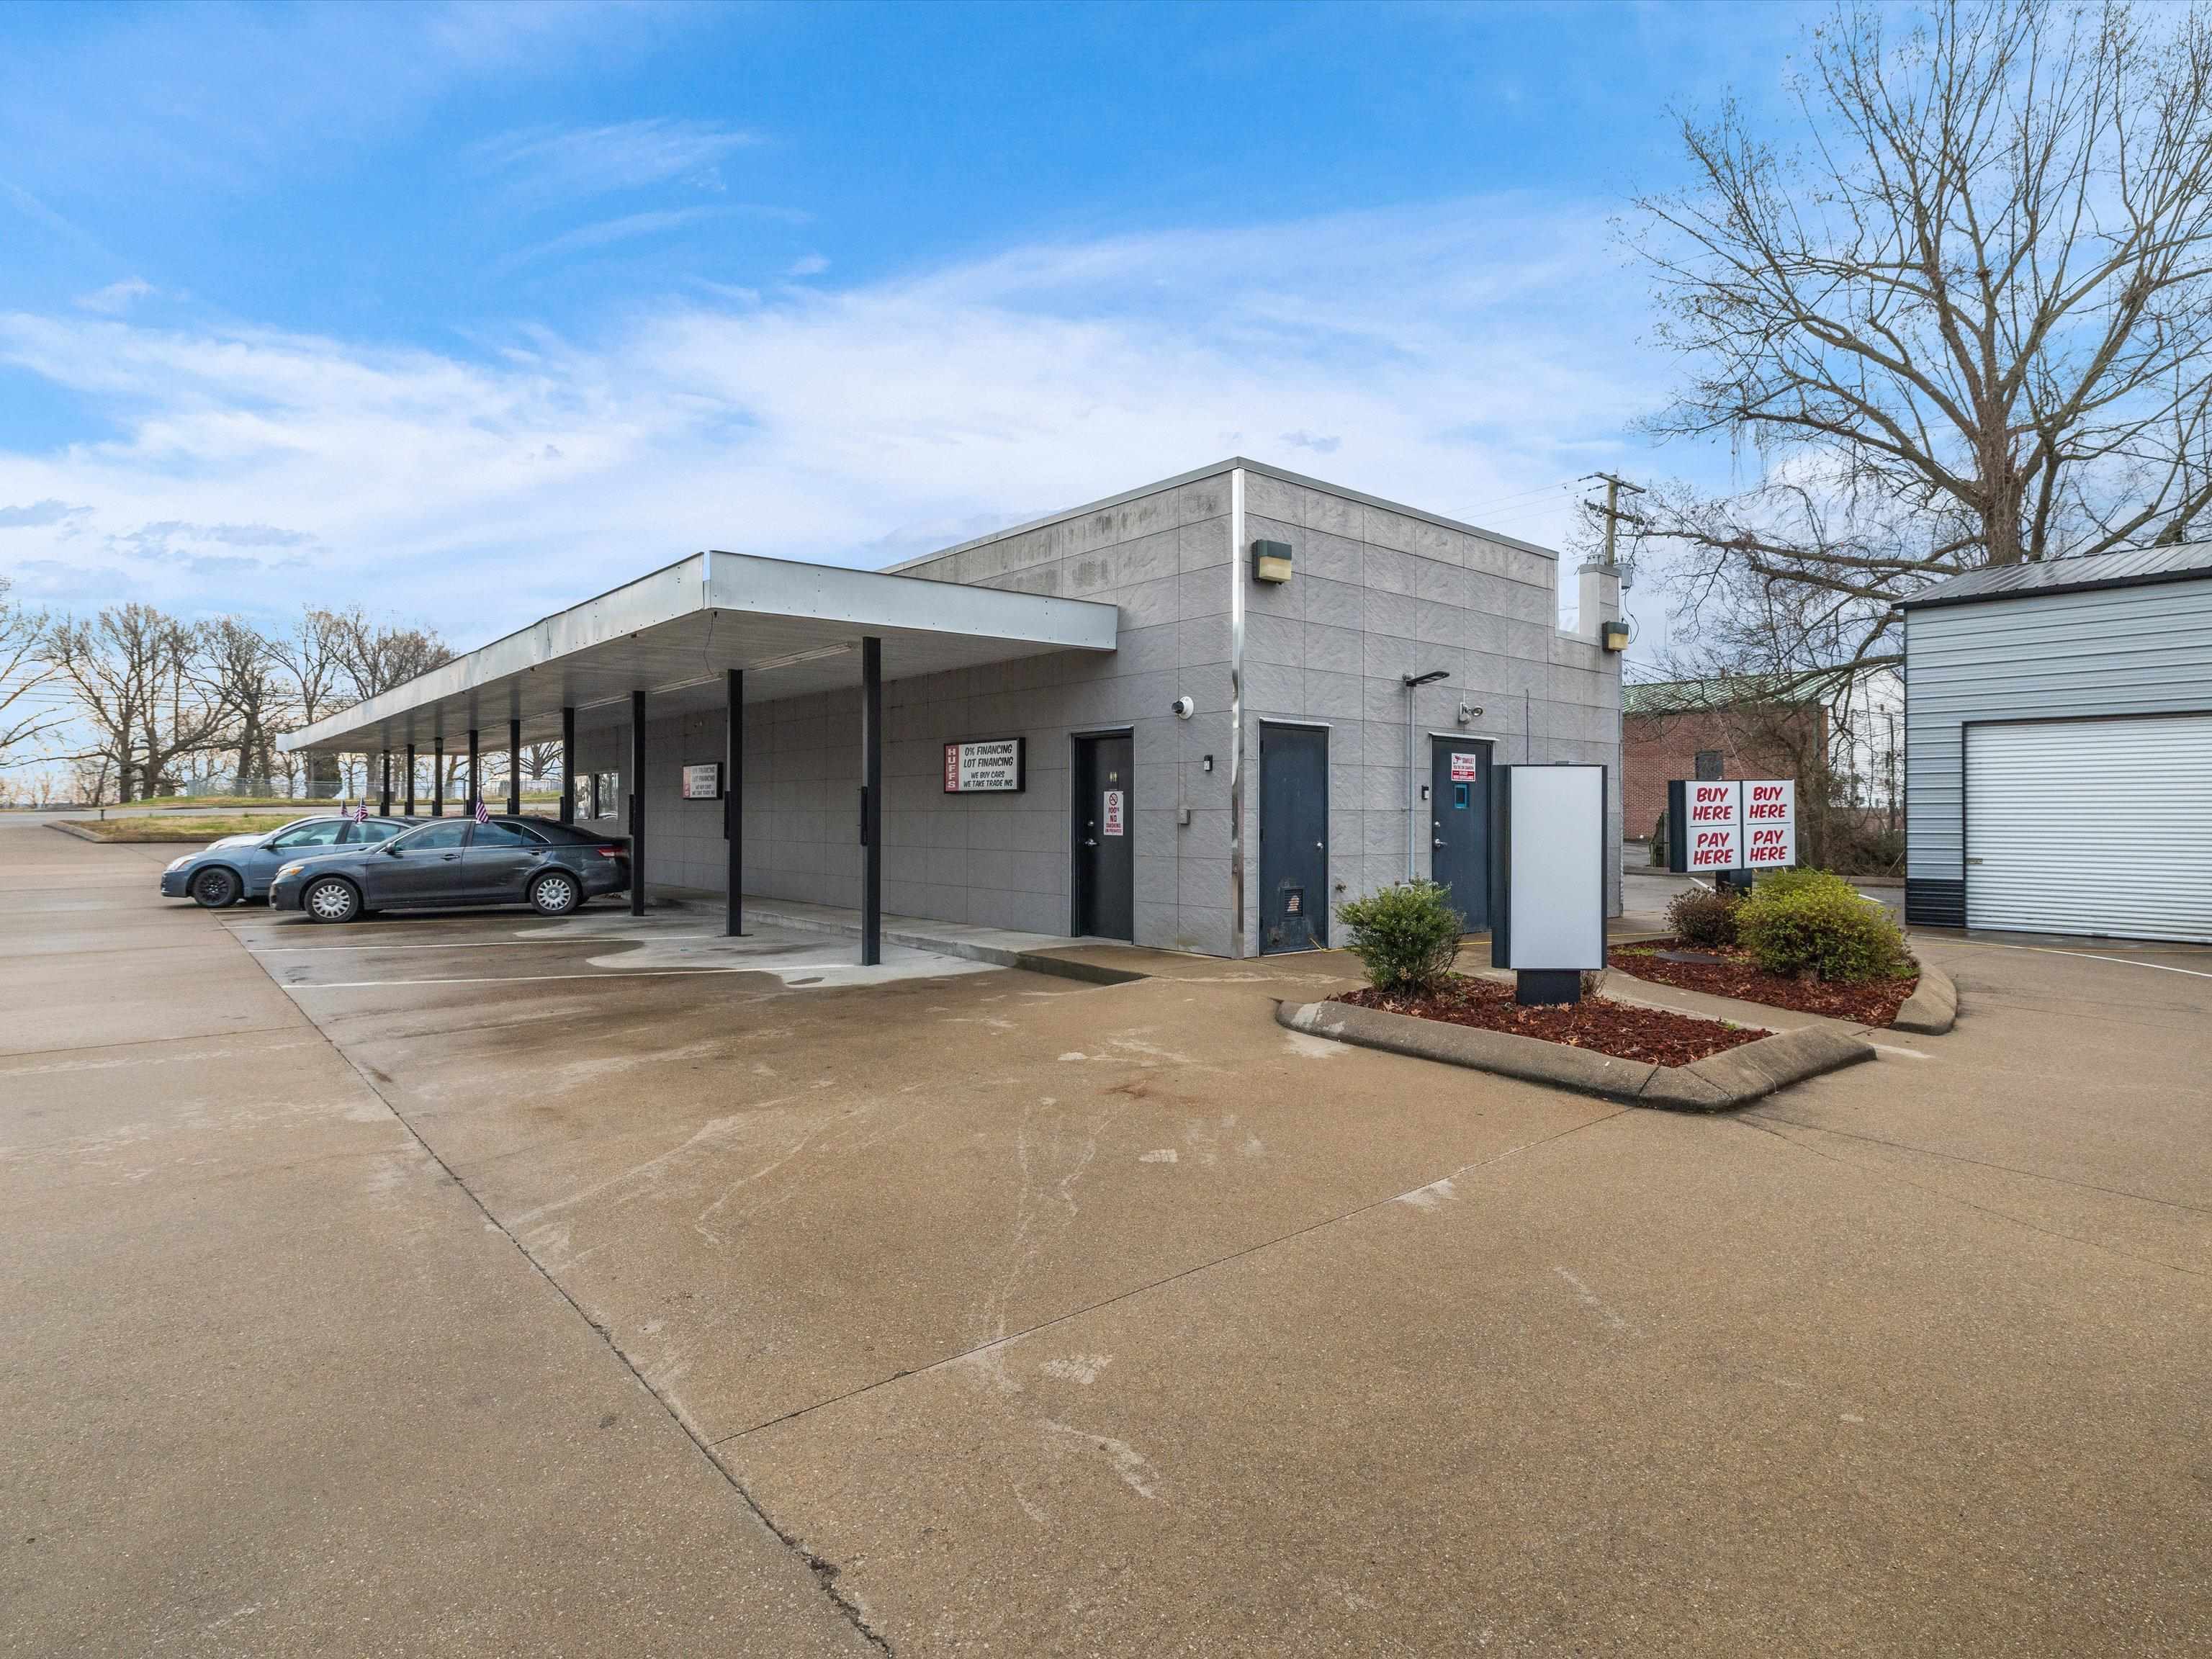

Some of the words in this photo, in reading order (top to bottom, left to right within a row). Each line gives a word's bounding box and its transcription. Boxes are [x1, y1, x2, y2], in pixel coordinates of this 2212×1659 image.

[965, 747, 975, 756] 0%
[977, 744, 1012, 755] FINANCING
[948, 748, 956, 788] HUFFS
[963, 758, 976, 768] LOT
[978, 756, 1013, 767] FINANCING
[1696, 787, 1728, 802] BUY
[1753, 786, 1783, 801] BUY
[1693, 805, 1733, 821] HERE
[1749, 804, 1787, 819] HERE
[1697, 832, 1730, 848] PAY
[1753, 830, 1784, 845] PAY
[1694, 849, 1734, 865] HERE
[1750, 846, 1787, 861] HERE
